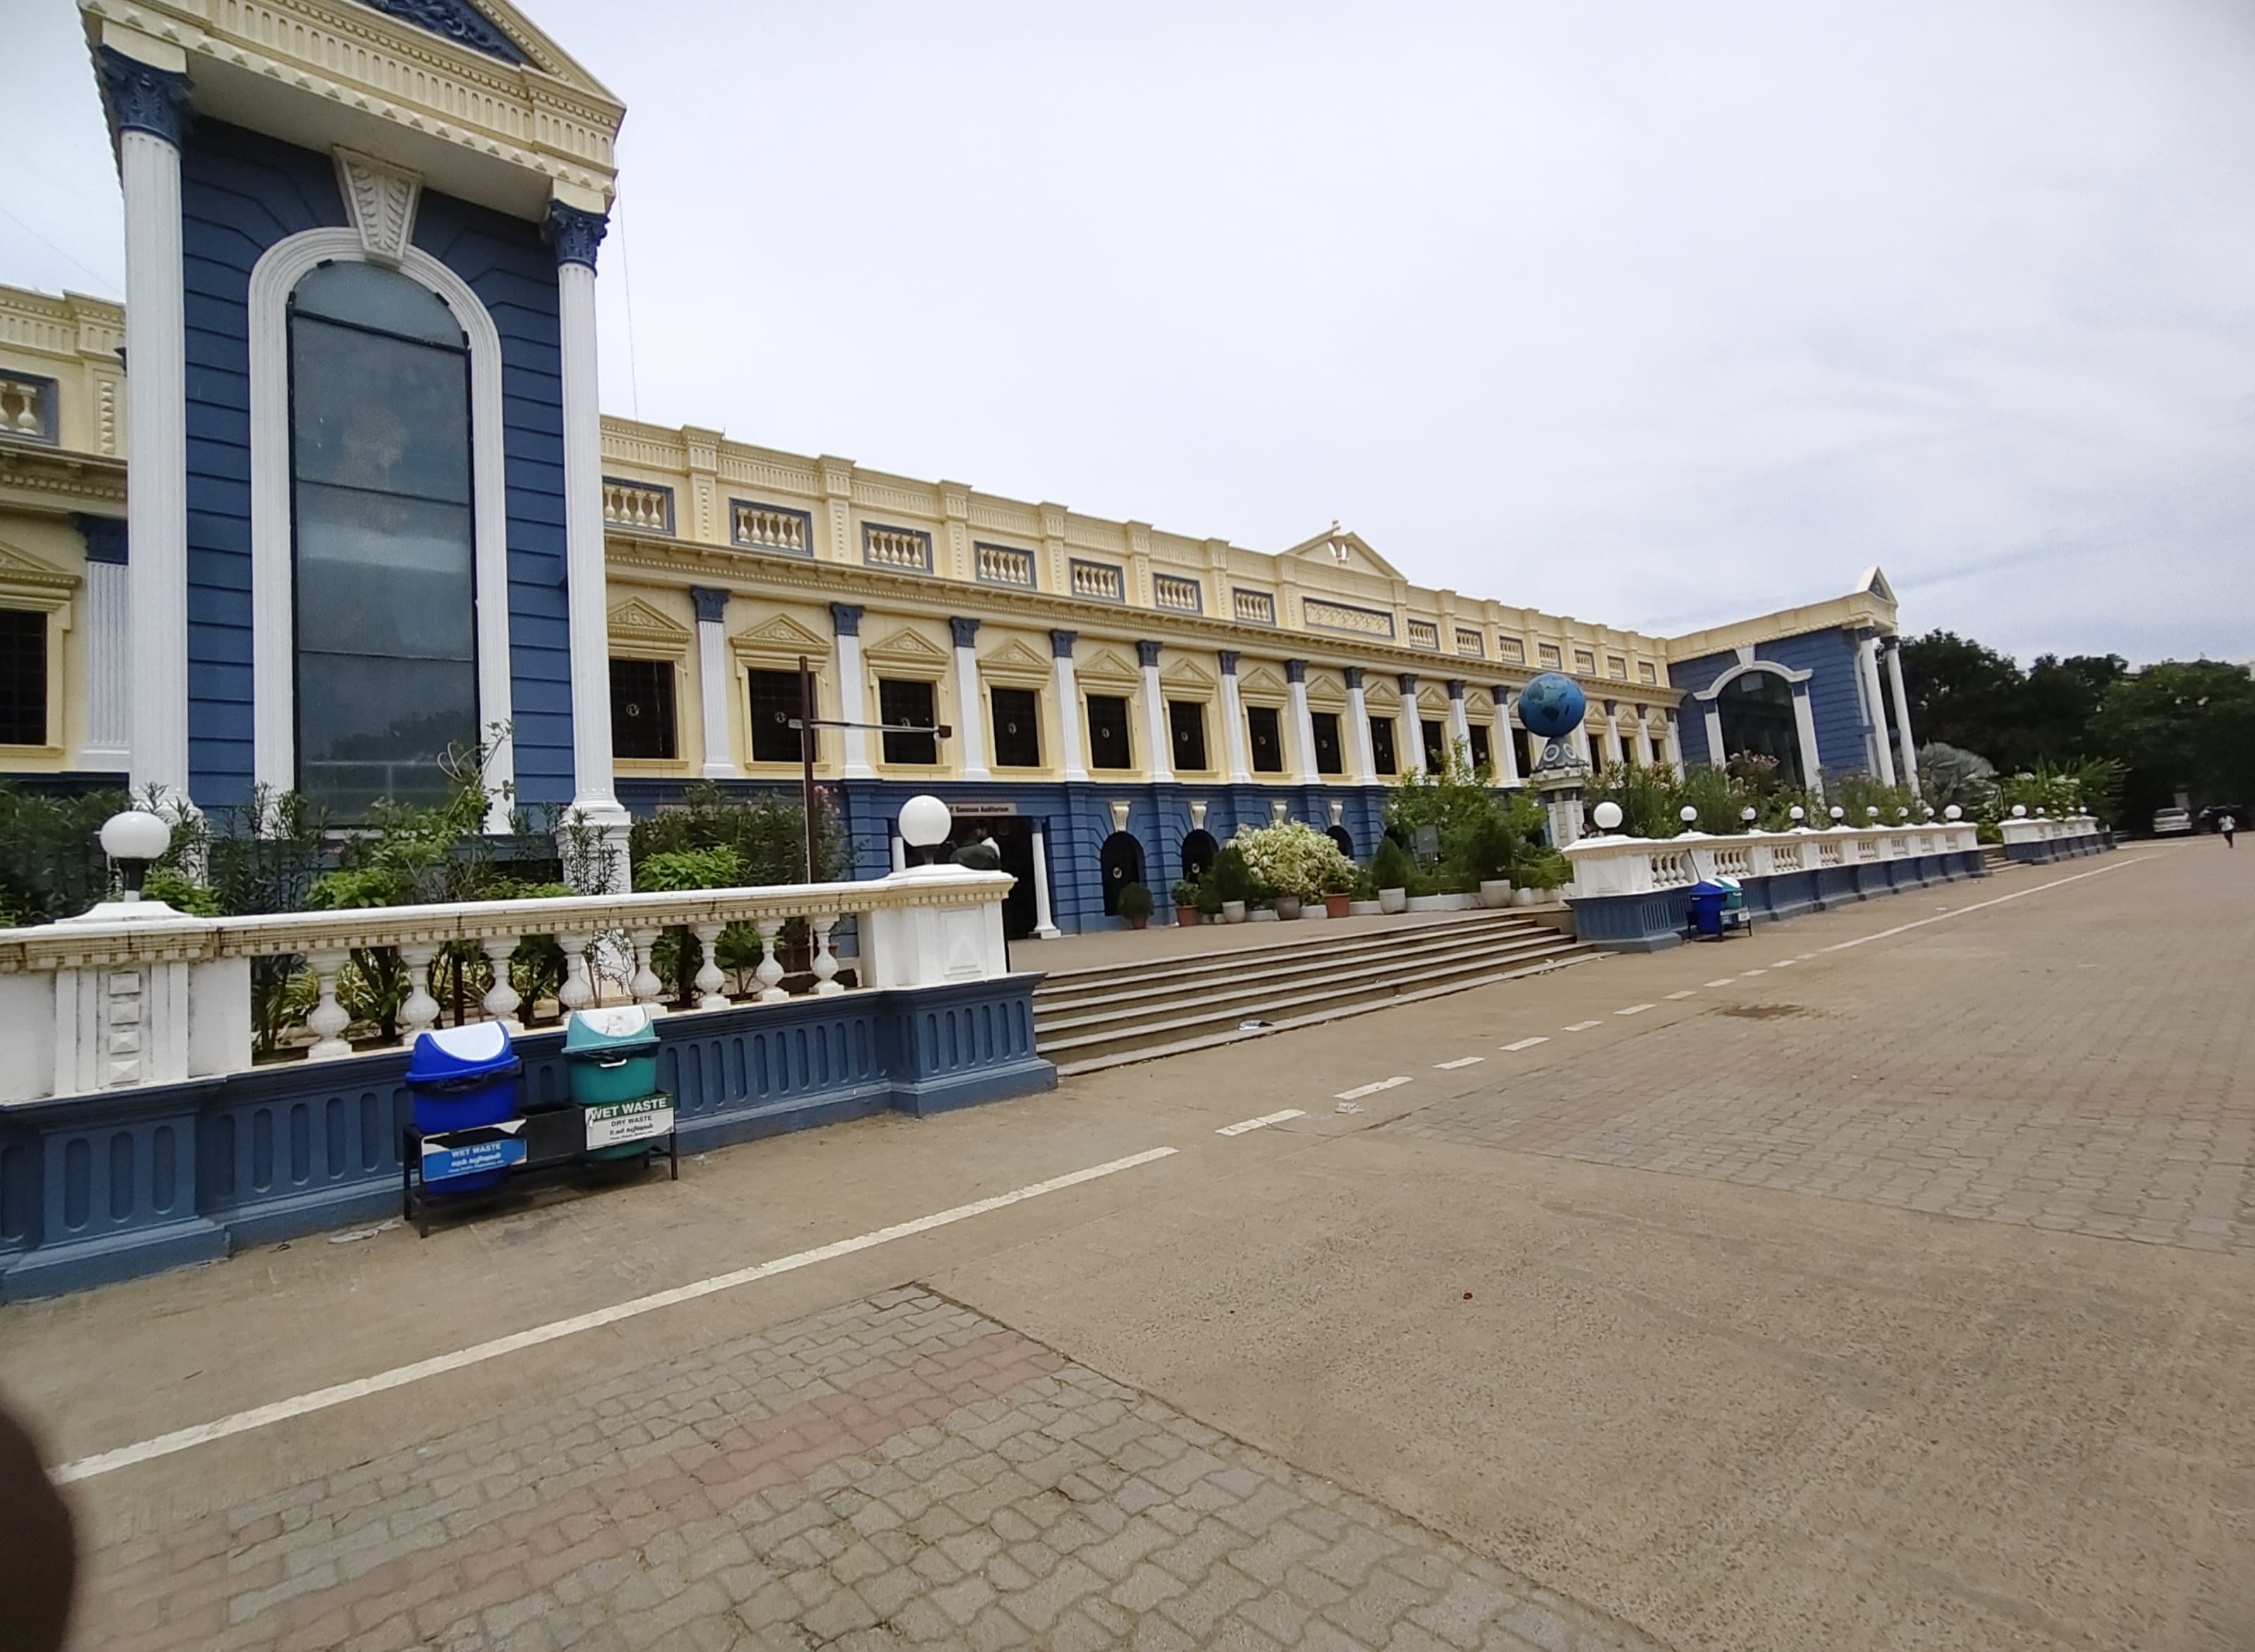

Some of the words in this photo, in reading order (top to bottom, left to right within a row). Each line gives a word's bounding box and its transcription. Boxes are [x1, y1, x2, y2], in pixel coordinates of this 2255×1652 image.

[591, 1105, 619, 1119] WET
[622, 1097, 667, 1114] WASTE
[628, 1115, 652, 1124] WASTE
[451, 1148, 471, 1158] WET
[472, 1143, 501, 1154] WASTE
